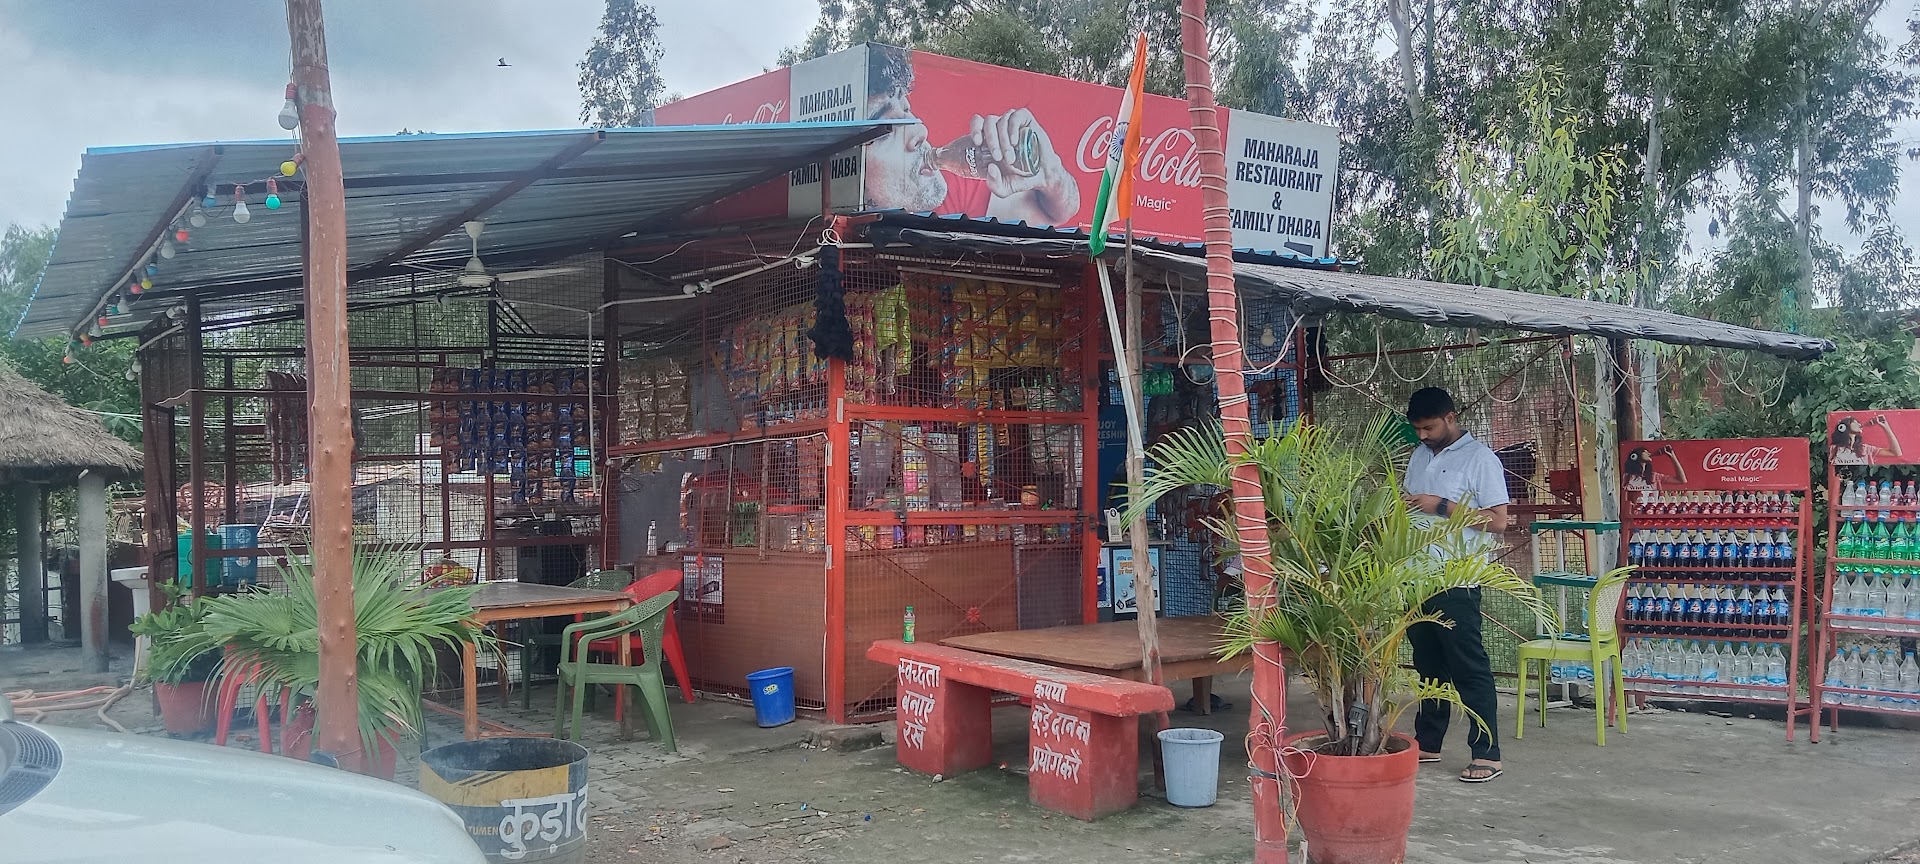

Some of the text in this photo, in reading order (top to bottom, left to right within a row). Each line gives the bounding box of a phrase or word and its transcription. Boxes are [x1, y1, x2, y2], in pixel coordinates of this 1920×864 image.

[799, 83, 852, 116] MAHARAJA
[1243, 137, 1319, 169] MAHARAJA
[829, 155, 858, 180] HABA
[1235, 161, 1323, 193] RESTAURANT
[1271, 191, 1282, 210] &
[1277, 214, 1321, 240] DHABA
[1702, 446, 1783, 472] Coca-Cola
[467, 826, 499, 836] TUMEN
